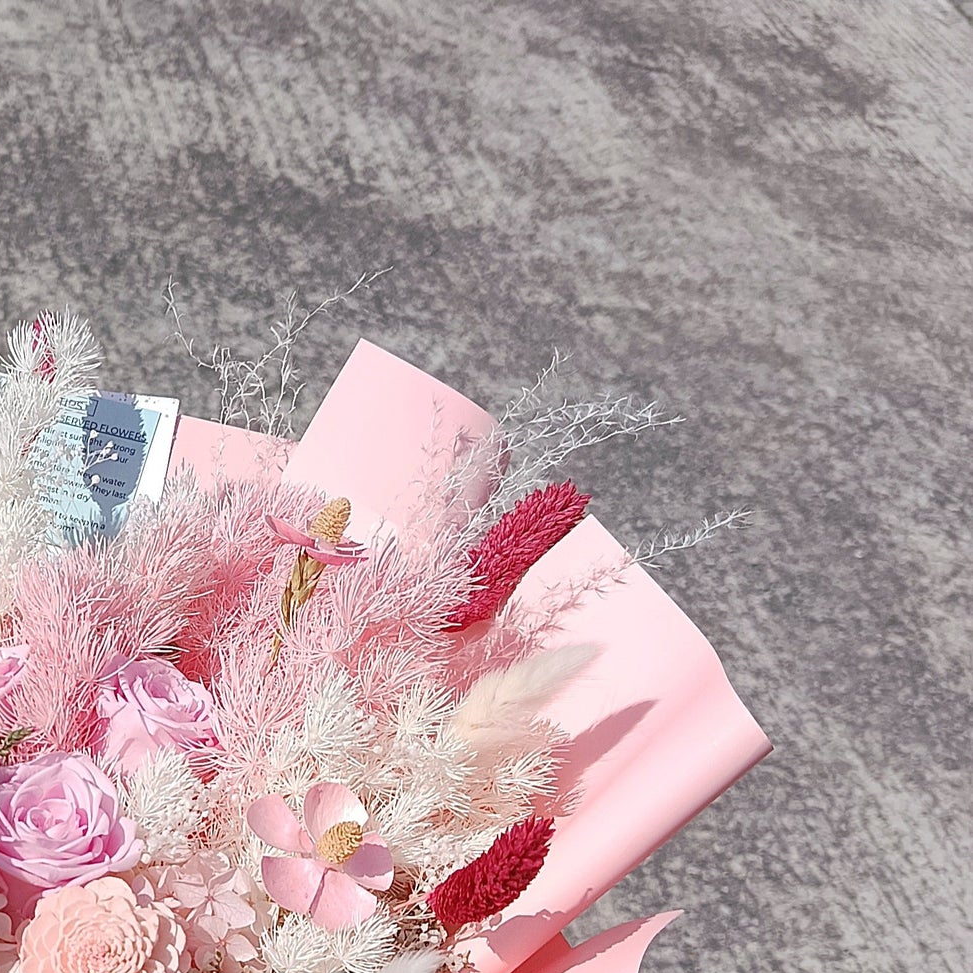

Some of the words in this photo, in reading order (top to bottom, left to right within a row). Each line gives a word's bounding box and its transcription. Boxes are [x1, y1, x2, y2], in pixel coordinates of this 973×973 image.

[55, 414, 98, 430] SERVED
[99, 423, 147, 443] FLOWERS
[44, 427, 68, 438] dirct
[69, 433, 102, 448] sunlght
[109, 442, 137, 457] trong
[102, 477, 126, 488] water
[76, 493, 91, 503] dry
[91, 484, 112, 497] They
[112, 490, 127, 500] last
